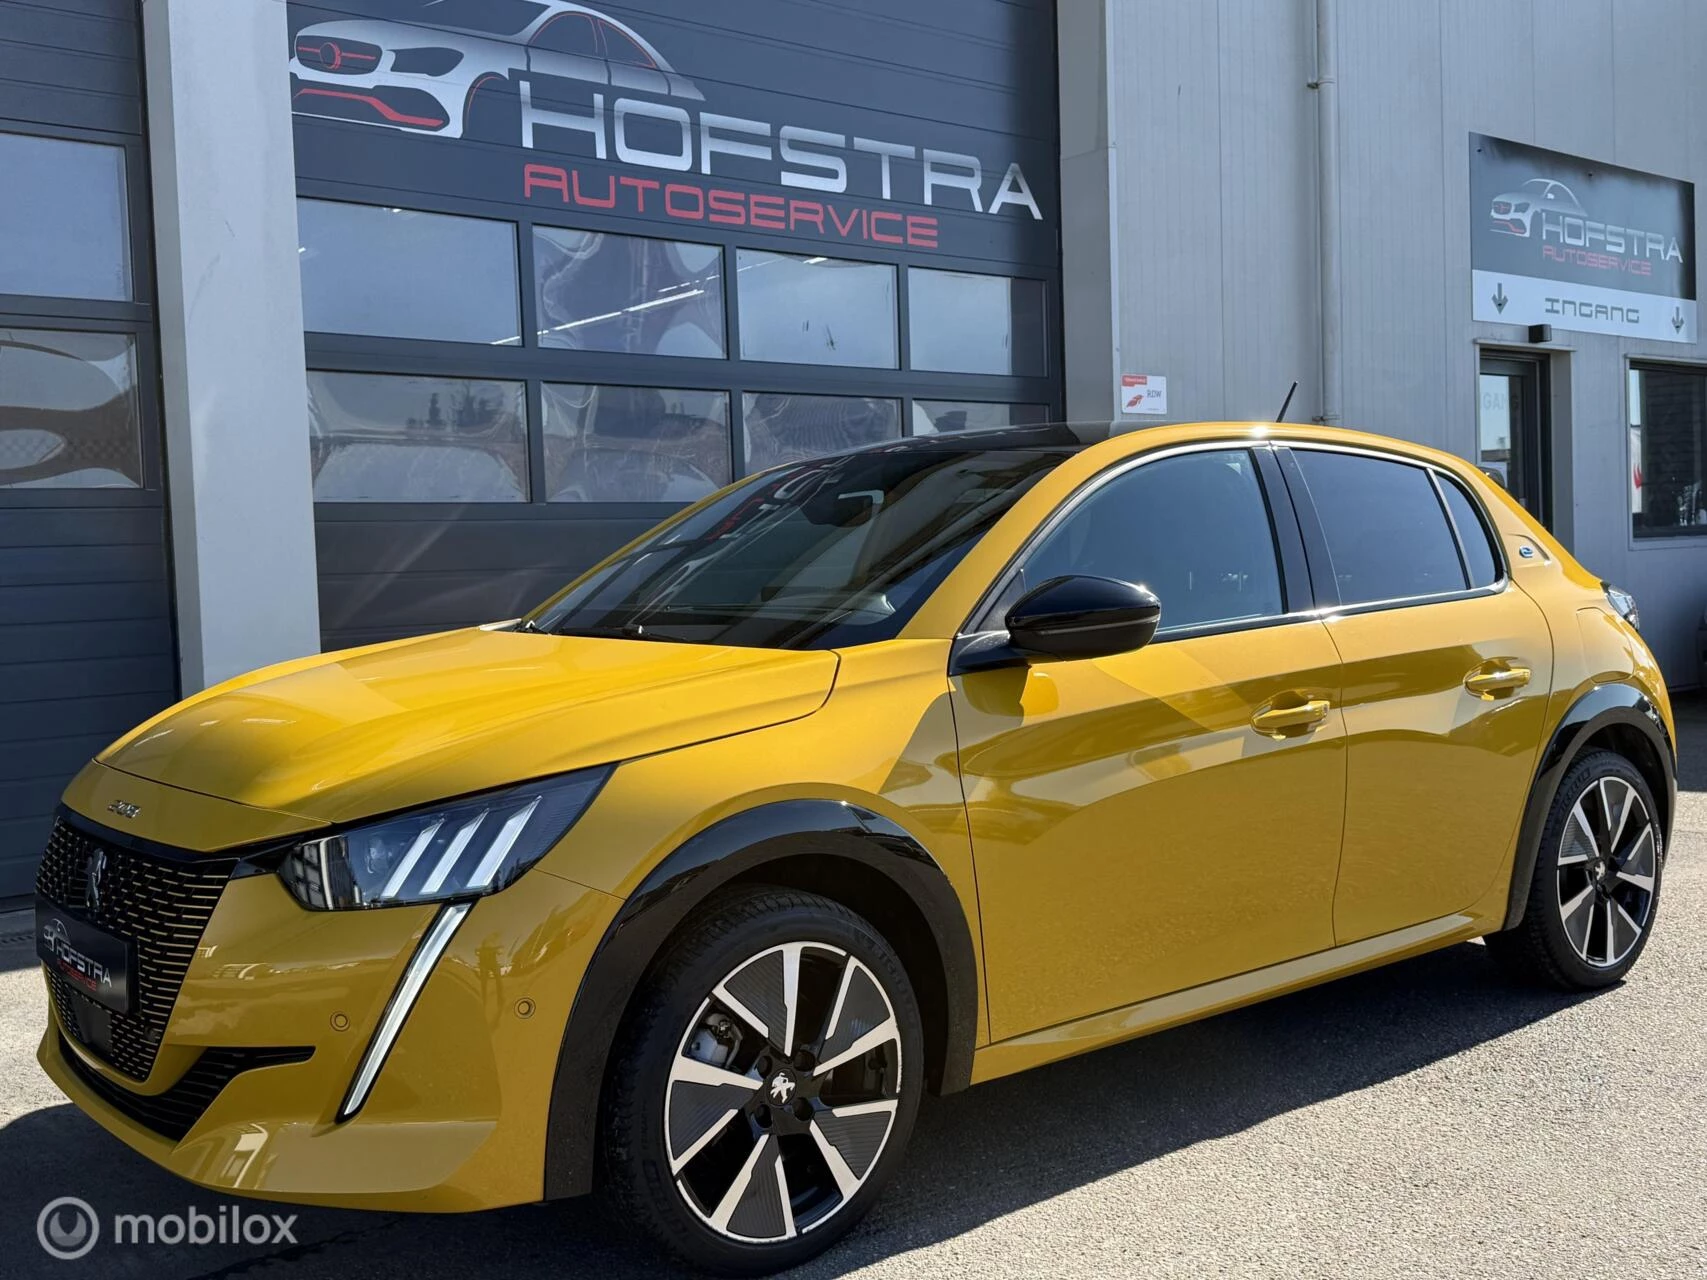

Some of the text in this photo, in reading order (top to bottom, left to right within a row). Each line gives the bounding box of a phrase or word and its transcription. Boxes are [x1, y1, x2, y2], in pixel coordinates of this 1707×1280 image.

[519, 80, 1043, 221] HOFSTRA
[524, 163, 939, 249] AUTOSERVICE
[1541, 213, 1684, 264] HOFSTRA
[1542, 245, 1652, 276] AUTOSERVICE
[1545, 297, 1640, 324] INGANG
[1146, 389, 1162, 398] RDW
[56, 939, 112, 988] HOFSTRA
